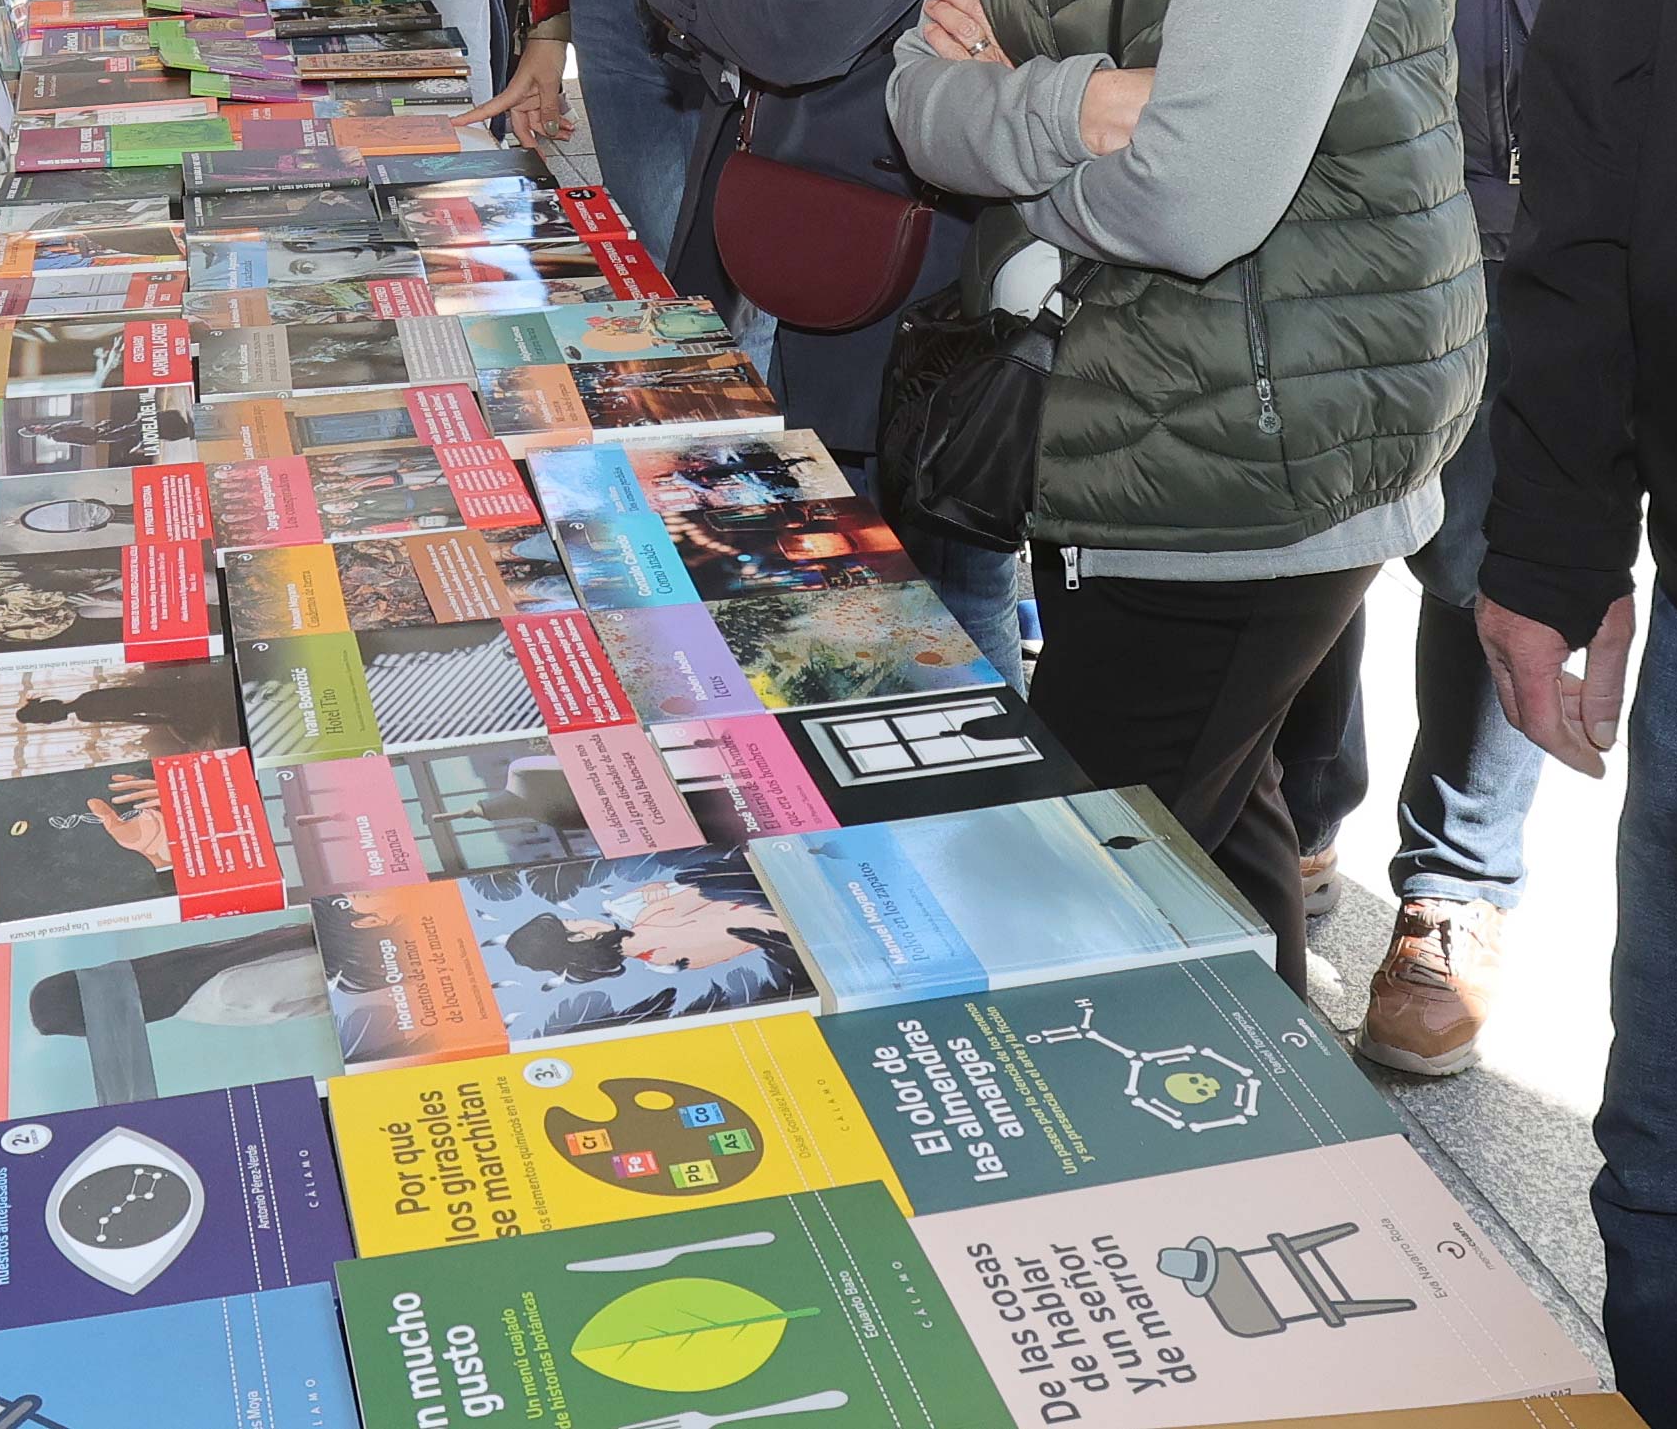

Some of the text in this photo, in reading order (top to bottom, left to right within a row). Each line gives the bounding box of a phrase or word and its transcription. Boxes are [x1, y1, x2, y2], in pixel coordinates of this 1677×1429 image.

[152, 350, 169, 378] CARMEN
[627, 566, 653, 598] Gonzalo
[653, 568, 674, 596] Como
[290, 666, 320, 738] Ivana Bodrožić
[319, 687, 344, 736] Hotel Tito
[673, 649, 709, 702] Rubén Abella
[708, 675, 732, 700] Ictus
[621, 751, 666, 827] Cristóbal Balenciaga
[720, 772, 762, 834] José Terradas
[721, 733, 772, 817] diario hombre
[746, 741, 806, 828] que dos hombres
[355, 814, 385, 877] Kepa Murua
[381, 828, 410, 874] Elegancia
[846, 880, 908, 968] Manuel Moyano
[856, 861, 901, 917] los zapatos
[379, 938, 415, 1032] Horacio Quiroga
[416, 982, 438, 1028] Cuentos
[693, 1106, 711, 1123] Co
[872, 1045, 953, 1156] El olor de
[896, 1018, 984, 1139] almendras
[946, 1036, 1026, 1139] amargas
[964, 1002, 1078, 1175] Un paseo ciencia venenos
[986, 1005, 1083, 1141] presencia ficción
[378, 1121, 431, 1217] Por qué
[416, 1089, 481, 1243] los girasoles
[455, 1081, 523, 1240] se marchitan
[497, 1075, 549, 1217] elementos arte
[581, 1133, 598, 1150] Cr
[625, 1154, 646, 1174] Fe
[685, 1164, 704, 1184] Pb
[723, 1132, 740, 1151] As
[967, 1141, 1010, 1183] las
[245, 1143, 271, 1230] Antonio Pérez-Verde
[386, 1291, 443, 1400] mucho
[521, 1291, 567, 1411] historias botánicas
[849, 1293, 880, 1339] Eduardo
[966, 1242, 1082, 1426] De las cosas
[1013, 1256, 1110, 1393] de hablar
[1049, 1243, 1168, 1395] y un señor
[1090, 1234, 1197, 1384] de marrón
[441, 1324, 505, 1418] gusto
[501, 1308, 544, 1420] Un menú cuajado
